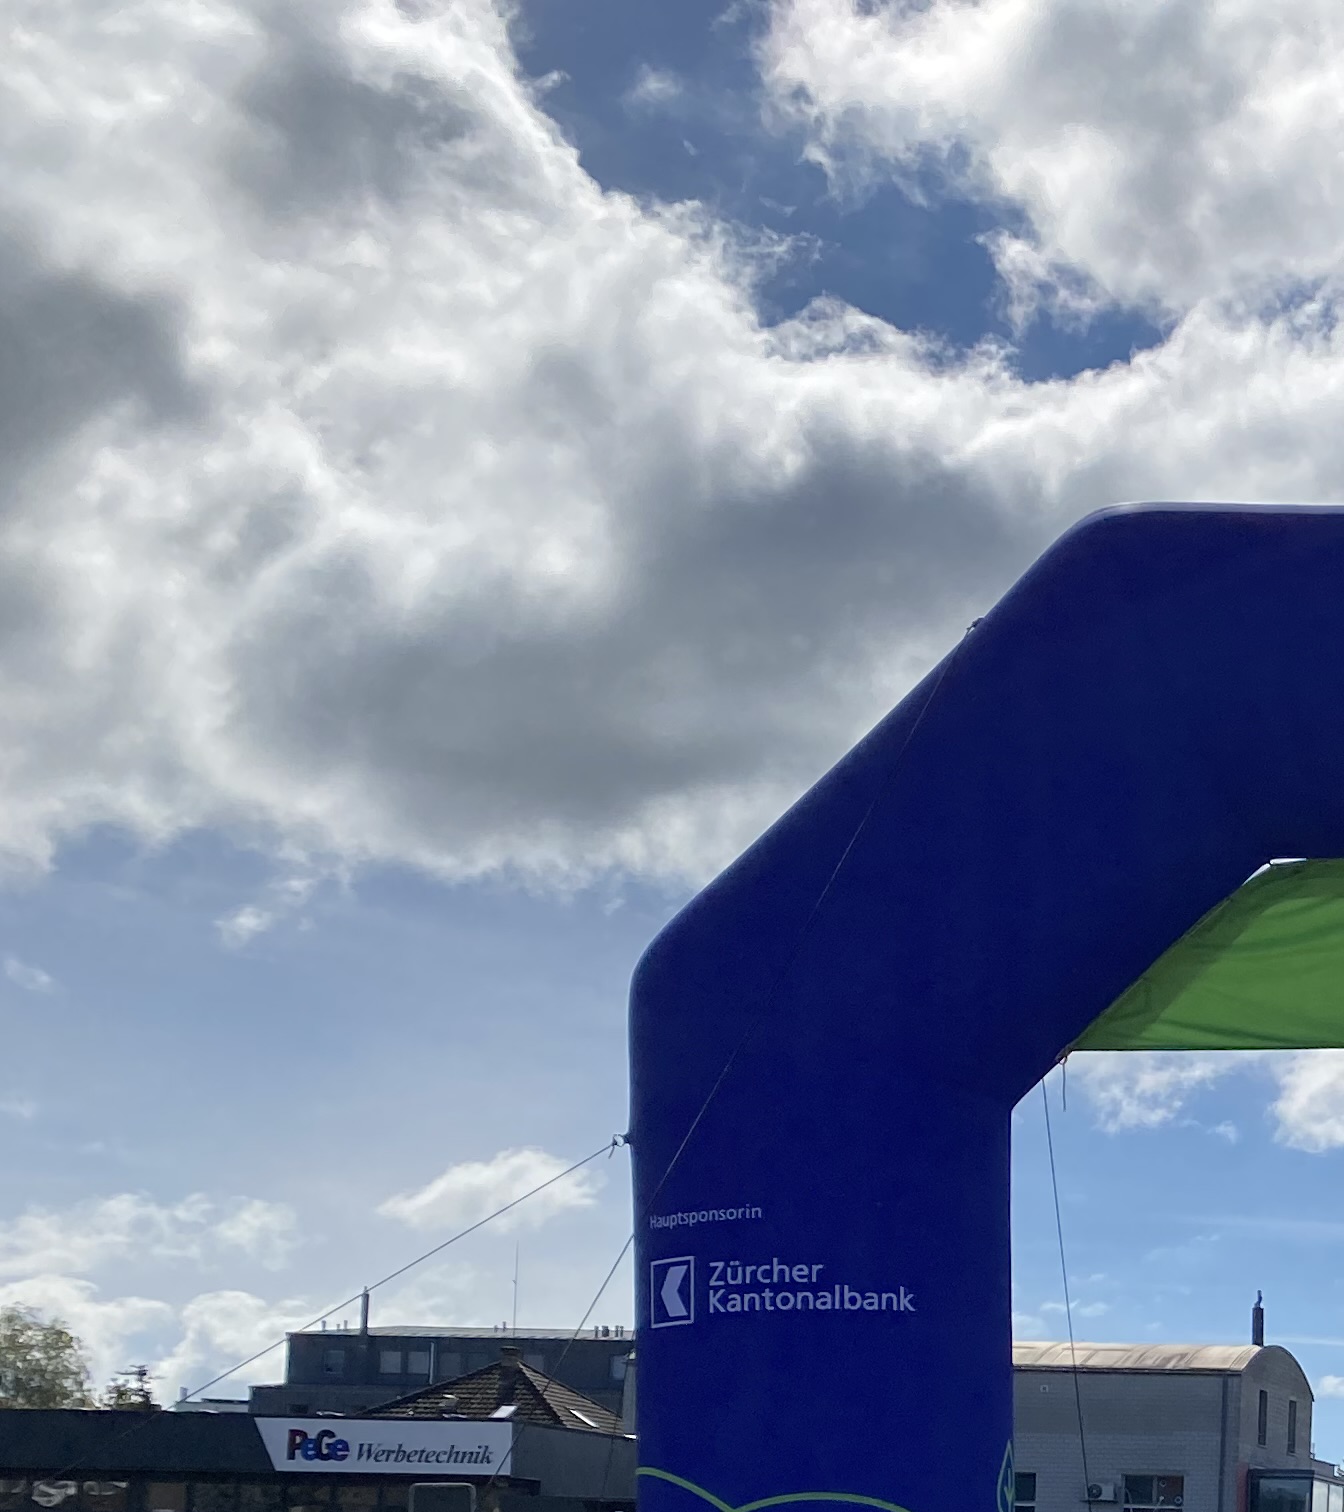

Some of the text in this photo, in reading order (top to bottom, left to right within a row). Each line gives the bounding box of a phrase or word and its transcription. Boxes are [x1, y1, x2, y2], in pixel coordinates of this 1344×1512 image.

[650, 1204, 762, 1229] Hauptsponsorin
[709, 1257, 824, 1286] Zürcher
[709, 1285, 916, 1313] Kantonalbank
[287, 1429, 494, 1465] PeGe Werbetechnik
